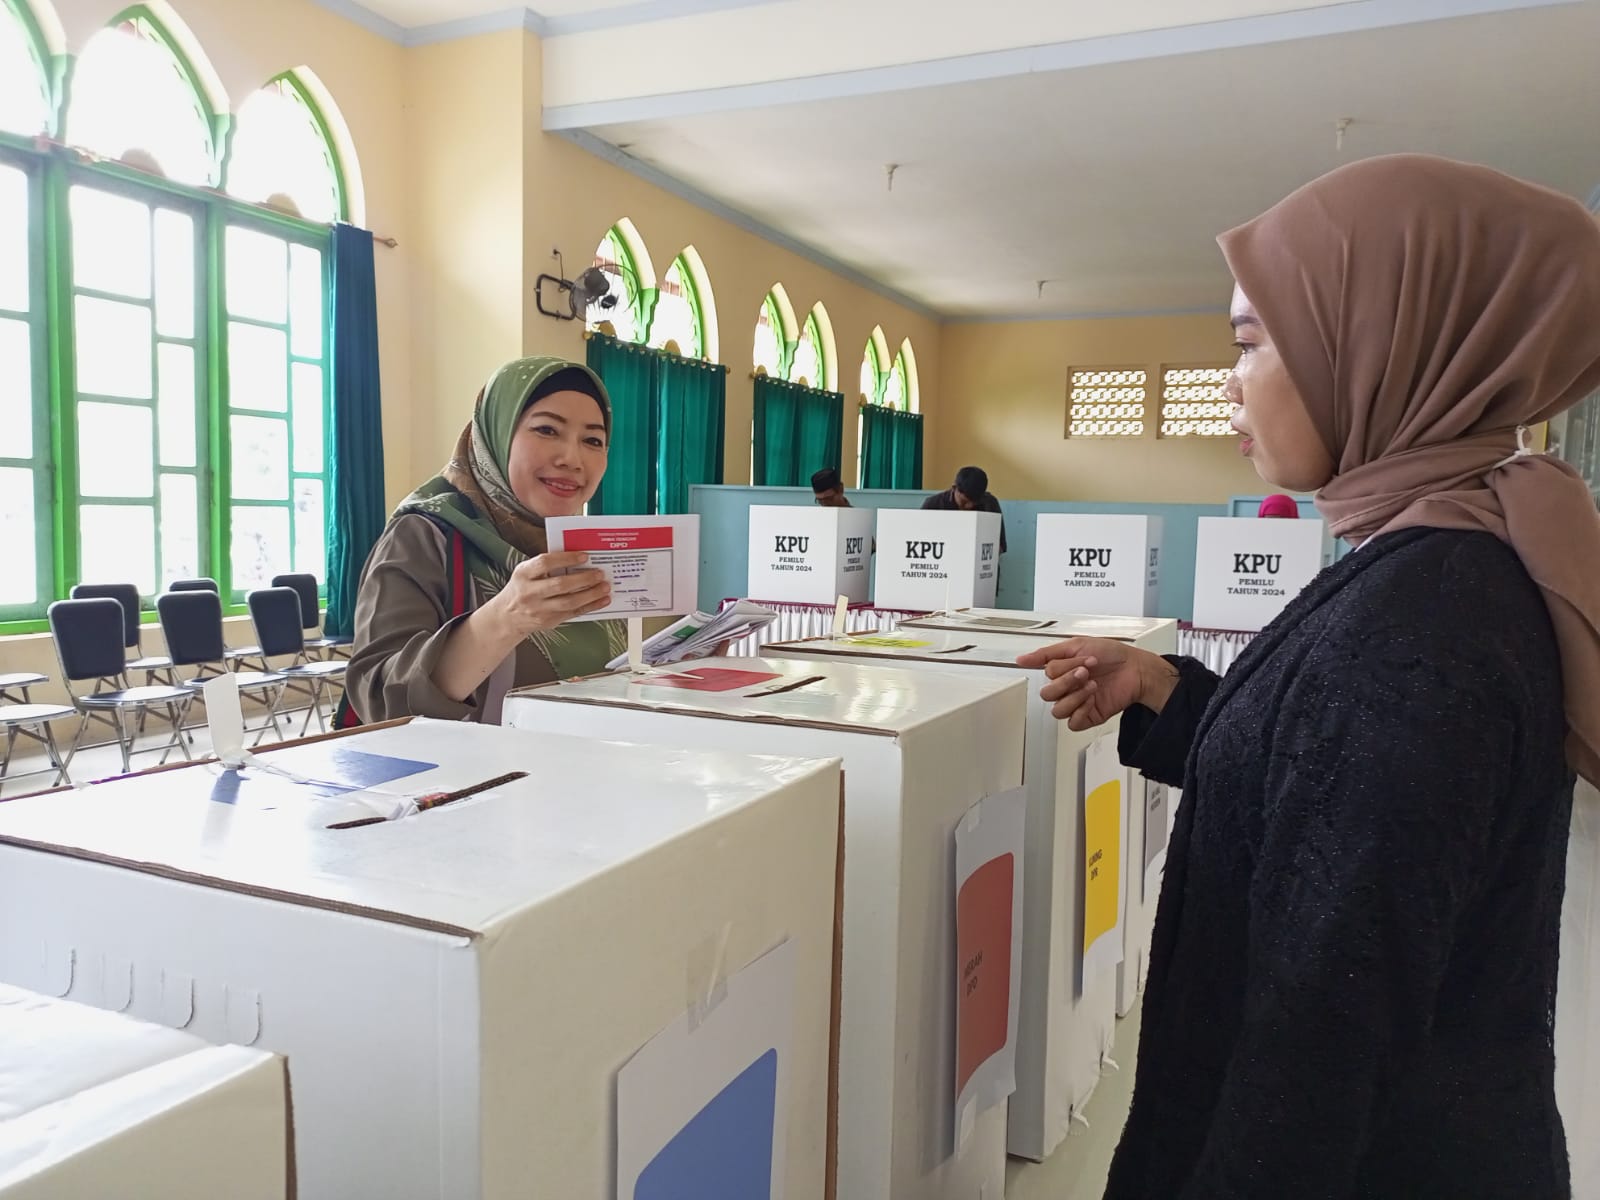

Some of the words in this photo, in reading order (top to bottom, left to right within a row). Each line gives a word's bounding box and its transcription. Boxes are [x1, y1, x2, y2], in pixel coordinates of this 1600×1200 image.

[775, 536, 809, 553] KPU
[846, 537, 863, 554] KPU
[905, 541, 945, 559] KPU
[1069, 548, 1112, 567] KPU
[1233, 553, 1282, 574] KPU
[1238, 578, 1274, 586] PEMILU
